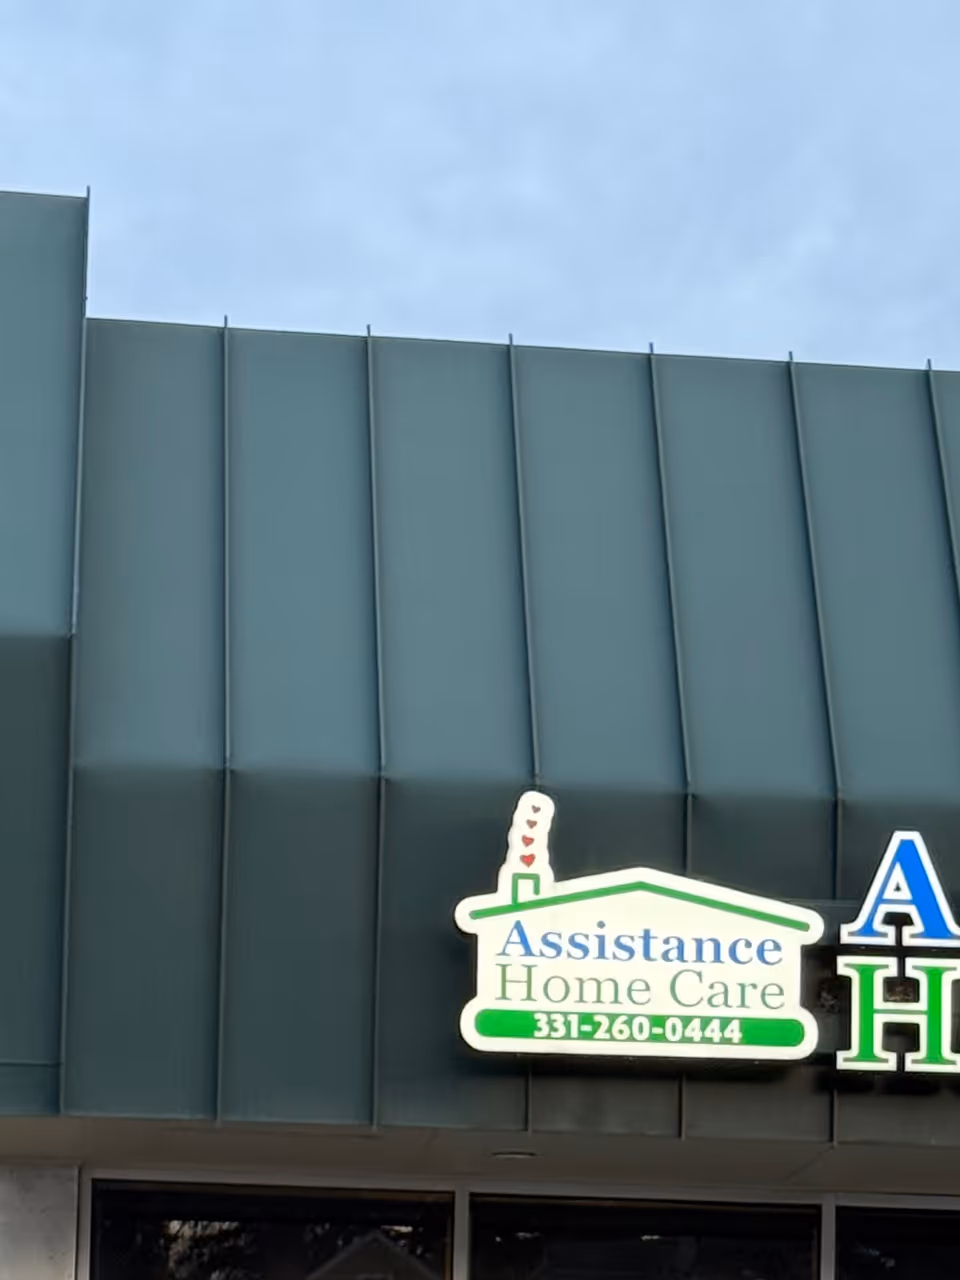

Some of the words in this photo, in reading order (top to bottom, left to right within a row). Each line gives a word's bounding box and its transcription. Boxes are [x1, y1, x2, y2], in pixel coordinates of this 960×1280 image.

[495, 920, 784, 966] Assistance
[495, 963, 652, 1007] Home
[669, 969, 786, 1010] Care
[532, 1012, 743, 1045] 331-260-0444
